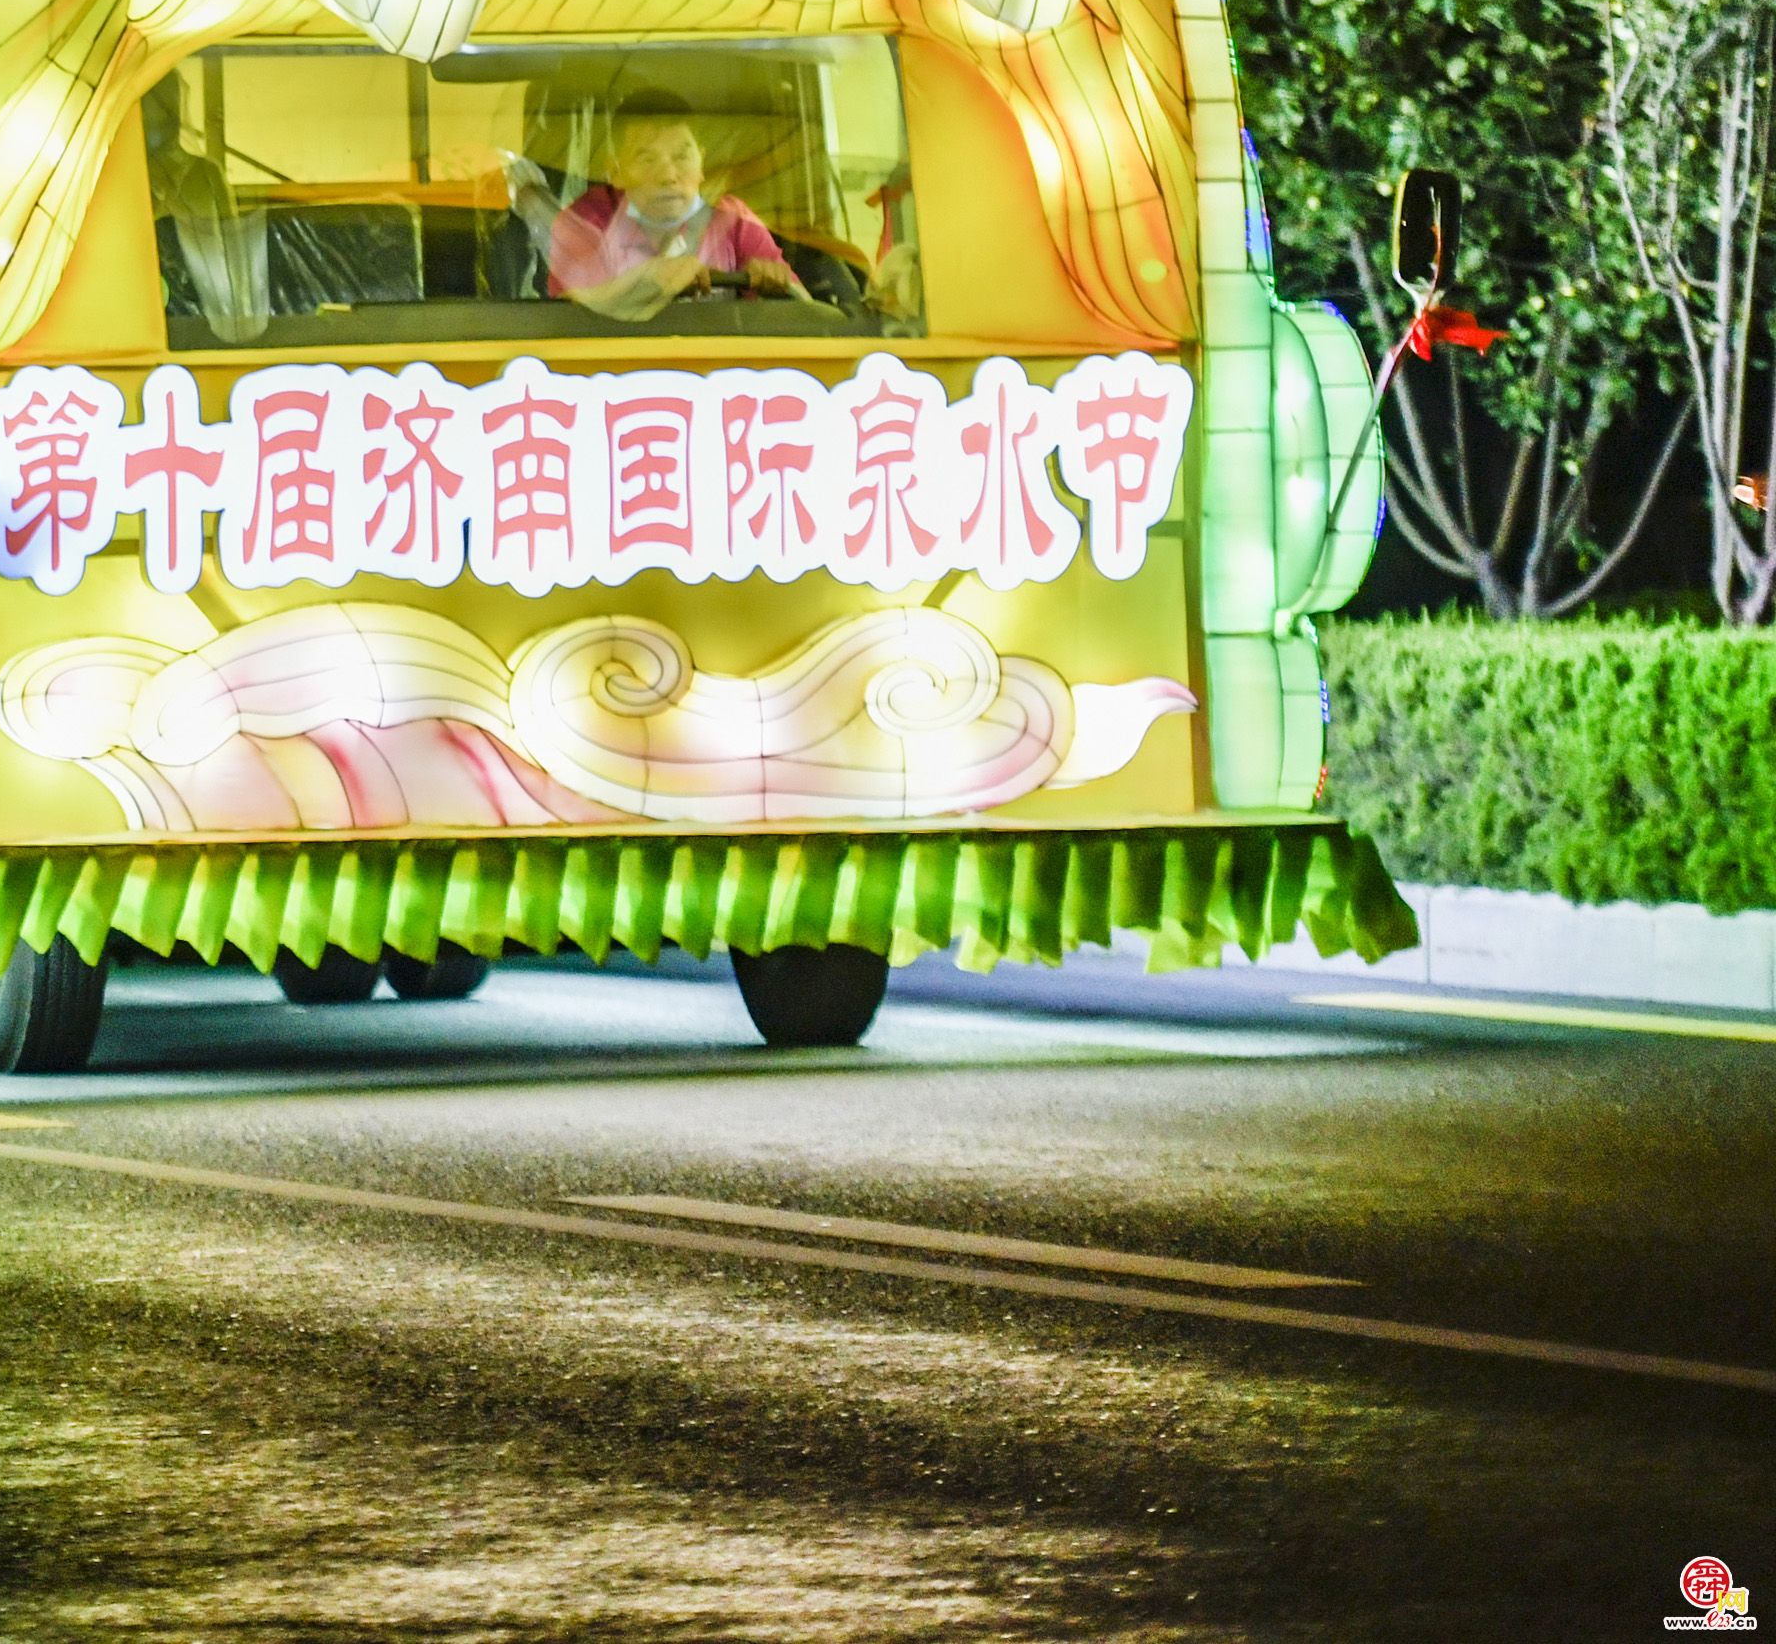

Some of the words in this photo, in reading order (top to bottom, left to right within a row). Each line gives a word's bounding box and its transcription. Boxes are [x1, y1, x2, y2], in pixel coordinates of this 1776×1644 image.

[3, 378, 1171, 571] 第十届济南国际泉水节
